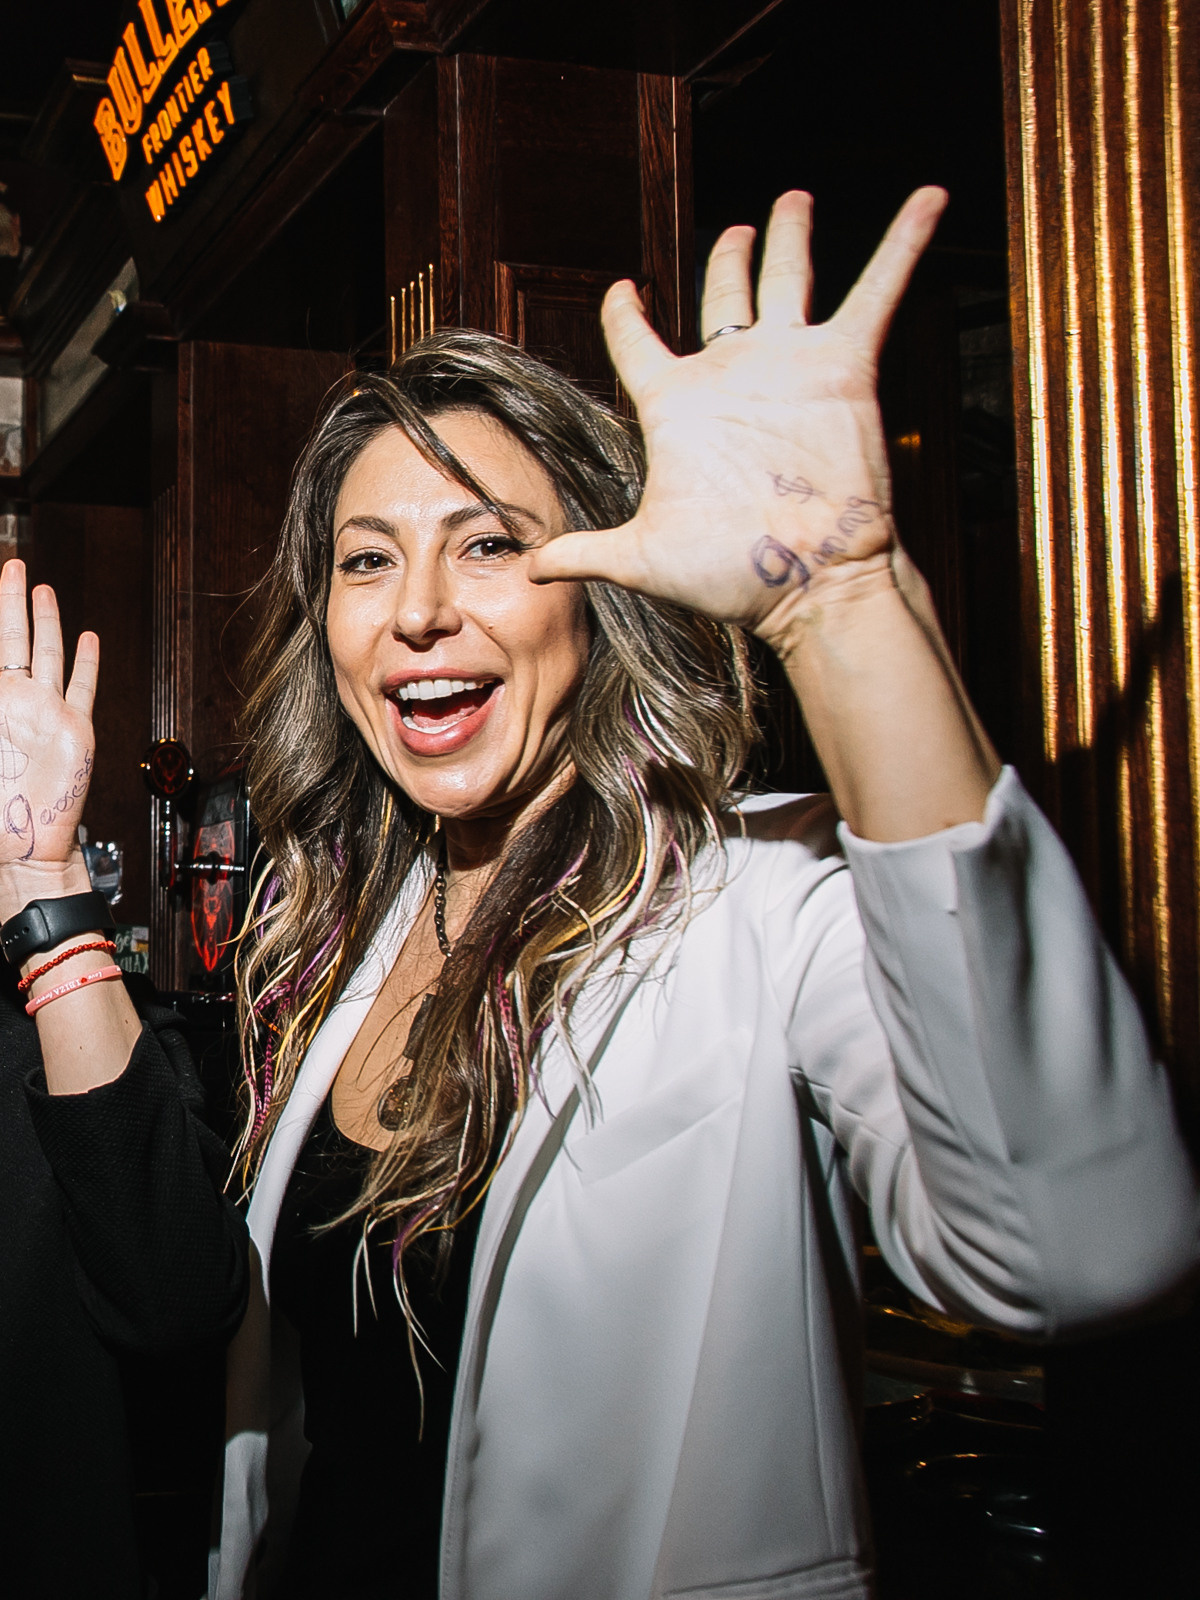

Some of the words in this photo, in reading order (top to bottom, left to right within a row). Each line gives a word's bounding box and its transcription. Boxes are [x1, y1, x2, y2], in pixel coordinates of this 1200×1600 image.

[94, 0, 230, 181] BULLE
[141, 47, 214, 164] FRONTIER
[145, 81, 235, 223] WHISKEY
